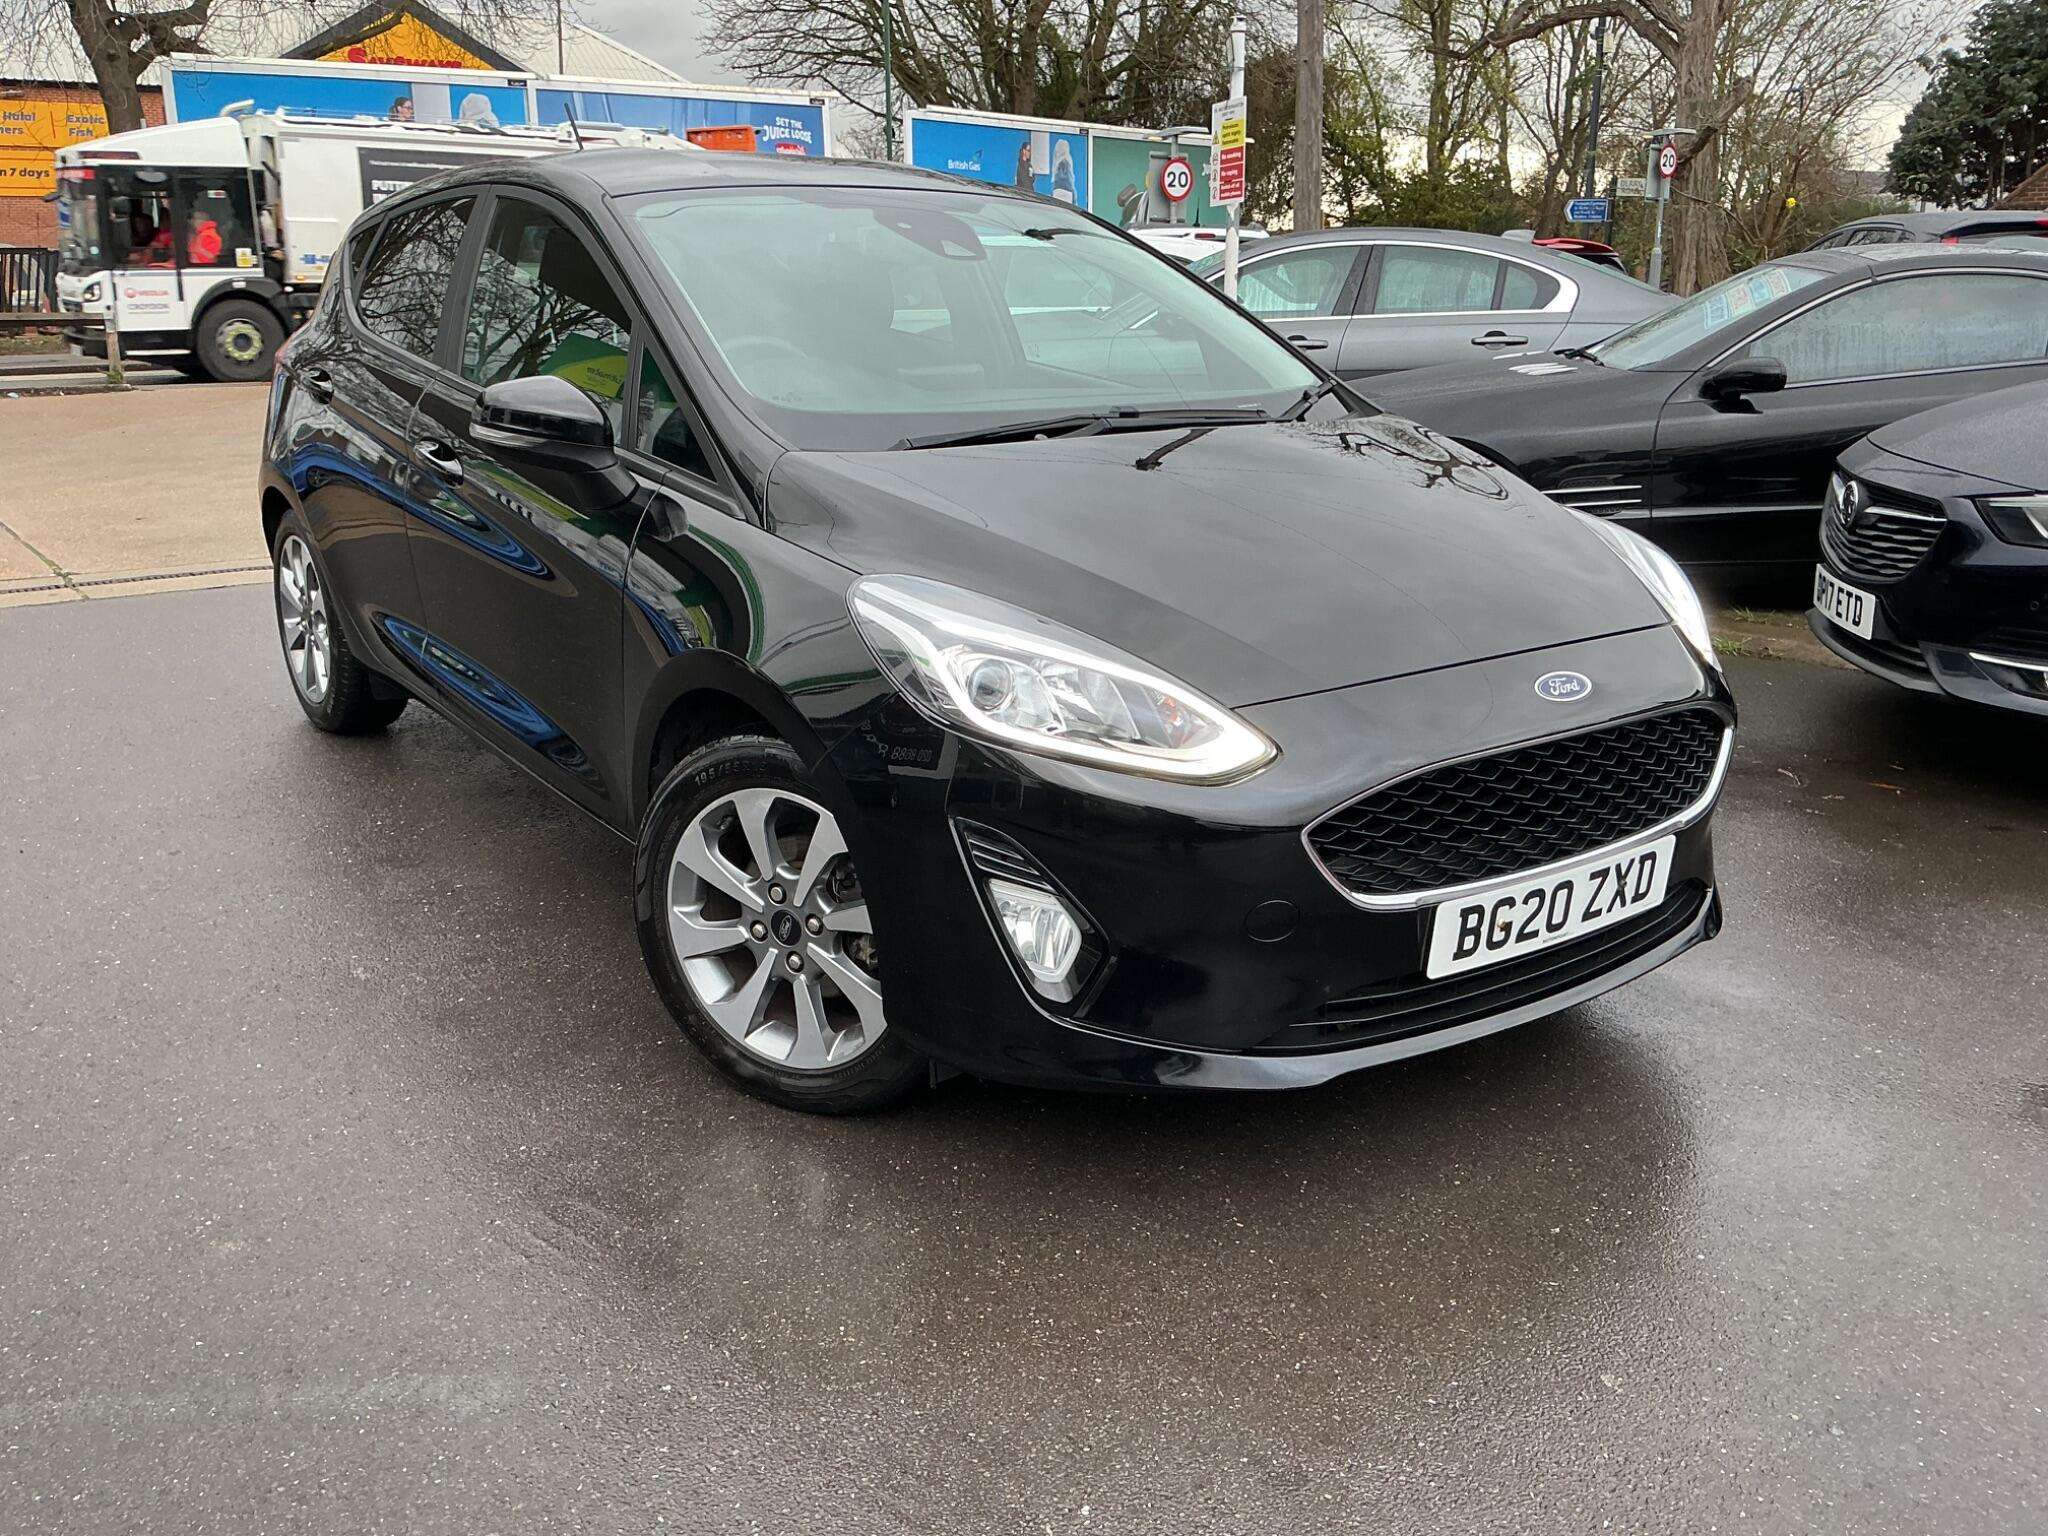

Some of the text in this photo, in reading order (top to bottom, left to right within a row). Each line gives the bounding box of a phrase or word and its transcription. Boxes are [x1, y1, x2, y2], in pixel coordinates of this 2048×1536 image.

[3, 111, 36, 121] Halal
[67, 114, 105, 124] Exotic
[775, 116, 803, 129] SET THE
[69, 127, 93, 137] Fish
[762, 125, 812, 144] JUICE LOOSE
[948, 159, 981, 171] British Gas
[1662, 153, 1675, 168] 20
[10, 168, 17, 177] 7
[19, 168, 50, 179] days
[1167, 171, 1189, 188] 20
[1836, 586, 1863, 627] ETD
[1549, 677, 1580, 695] Ford
[1452, 850, 1657, 962] BG20 ZXD
